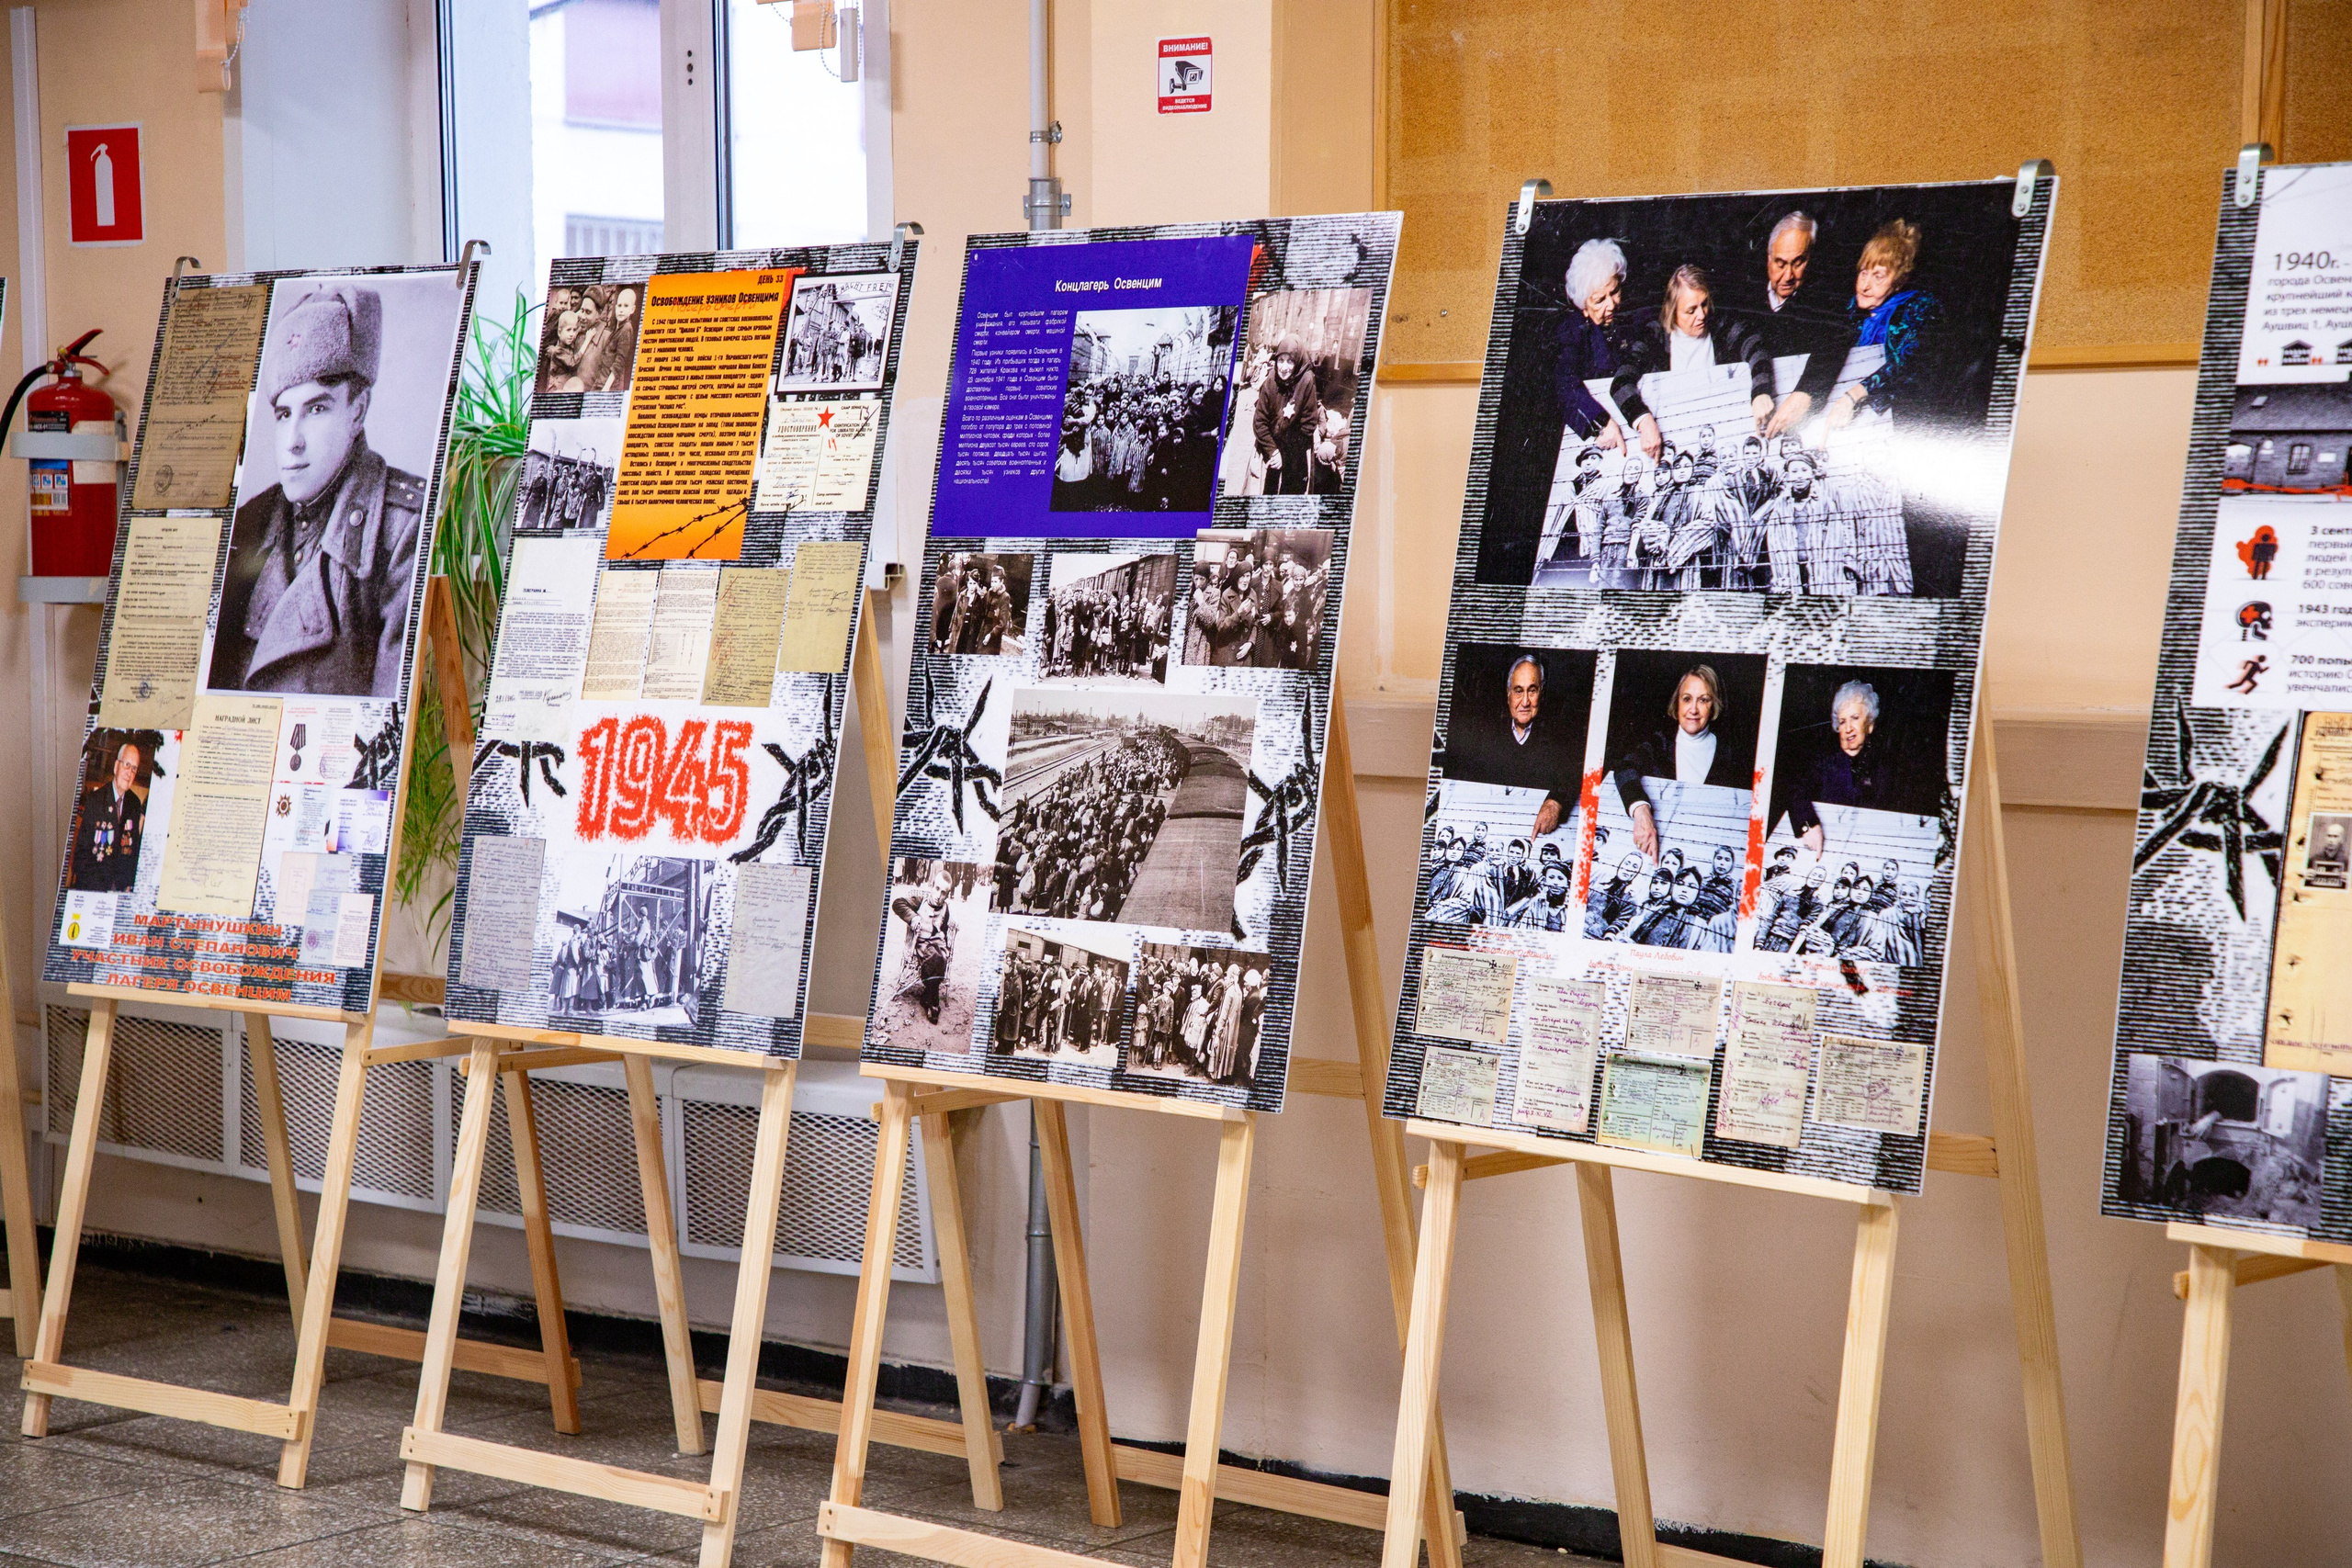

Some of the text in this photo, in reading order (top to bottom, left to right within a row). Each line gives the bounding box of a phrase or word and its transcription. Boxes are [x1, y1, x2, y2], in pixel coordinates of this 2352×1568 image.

[1163, 42, 1208, 52] ВНИМАНИЕ!
[2275, 251, 2340, 271] 1940г.
[757, 275, 784, 286] ДЕНЬ 33
[1055, 276, 1162, 293] Концлагерь Освенцим
[2267, 276, 2310, 287] города
[2266, 290, 2343, 302] крупнейший
[2262, 321, 2309, 333] Аушвиц
[2311, 526, 2319, 536] 3
[2306, 552, 2347, 563] людей
[2302, 580, 2325, 589] 600
[2299, 604, 2328, 614] 1943
[2291, 655, 2314, 665] 700
[2289, 671, 2345, 682] историю
[214, 715, 262, 725] НАГРАДНОЙ ЛИСТ
[576, 712, 755, 849] 1945
[133, 914, 283, 938] МАРТЫНУШКИН
[113, 932, 300, 961] ИВАН СТЕПАНОВИЧ
[1630, 949, 1685, 962] Паула Лебович
[71, 950, 336, 985] УЧАСТНИК ОСВОБОЖДЕНИЯ
[106, 973, 292, 1003] ЛАГЕРЯ ОСВЕНЦИМ
